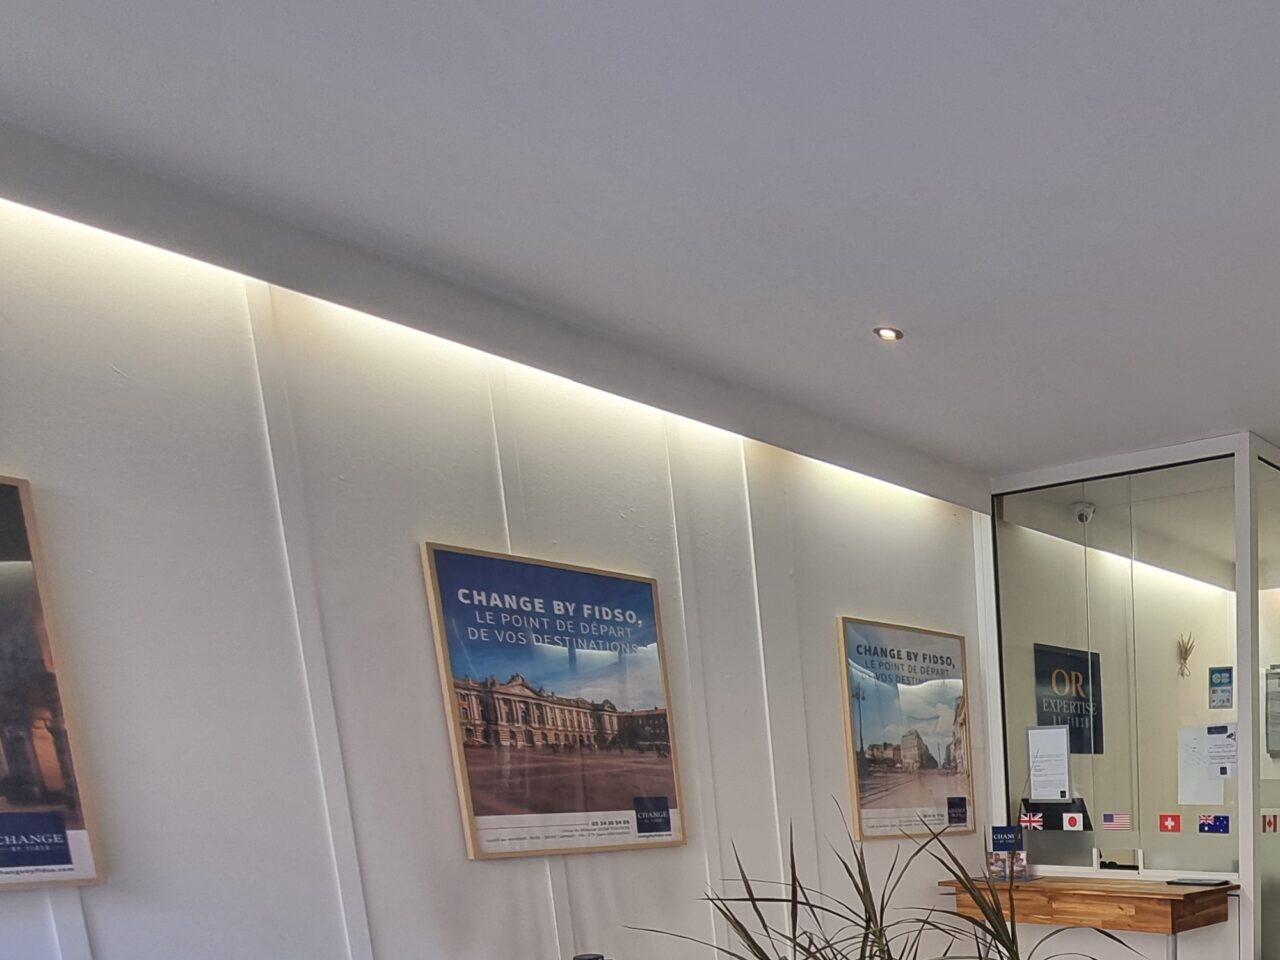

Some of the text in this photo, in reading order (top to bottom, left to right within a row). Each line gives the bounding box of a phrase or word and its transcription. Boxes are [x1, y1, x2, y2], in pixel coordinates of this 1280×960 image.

[457, 588, 643, 627] CHANGE BY FIDSO,
[467, 627, 490, 641] DE
[494, 630, 526, 645] VOS
[475, 611, 633, 638] LE POINT DE DÉPART
[856, 644, 955, 669] CHANGE BY FIDSO,
[864, 659, 949, 677] LE POINT DE DÉPART
[1051, 668, 1086, 698] OR
[1042, 698, 1098, 715] EXPERTISE
